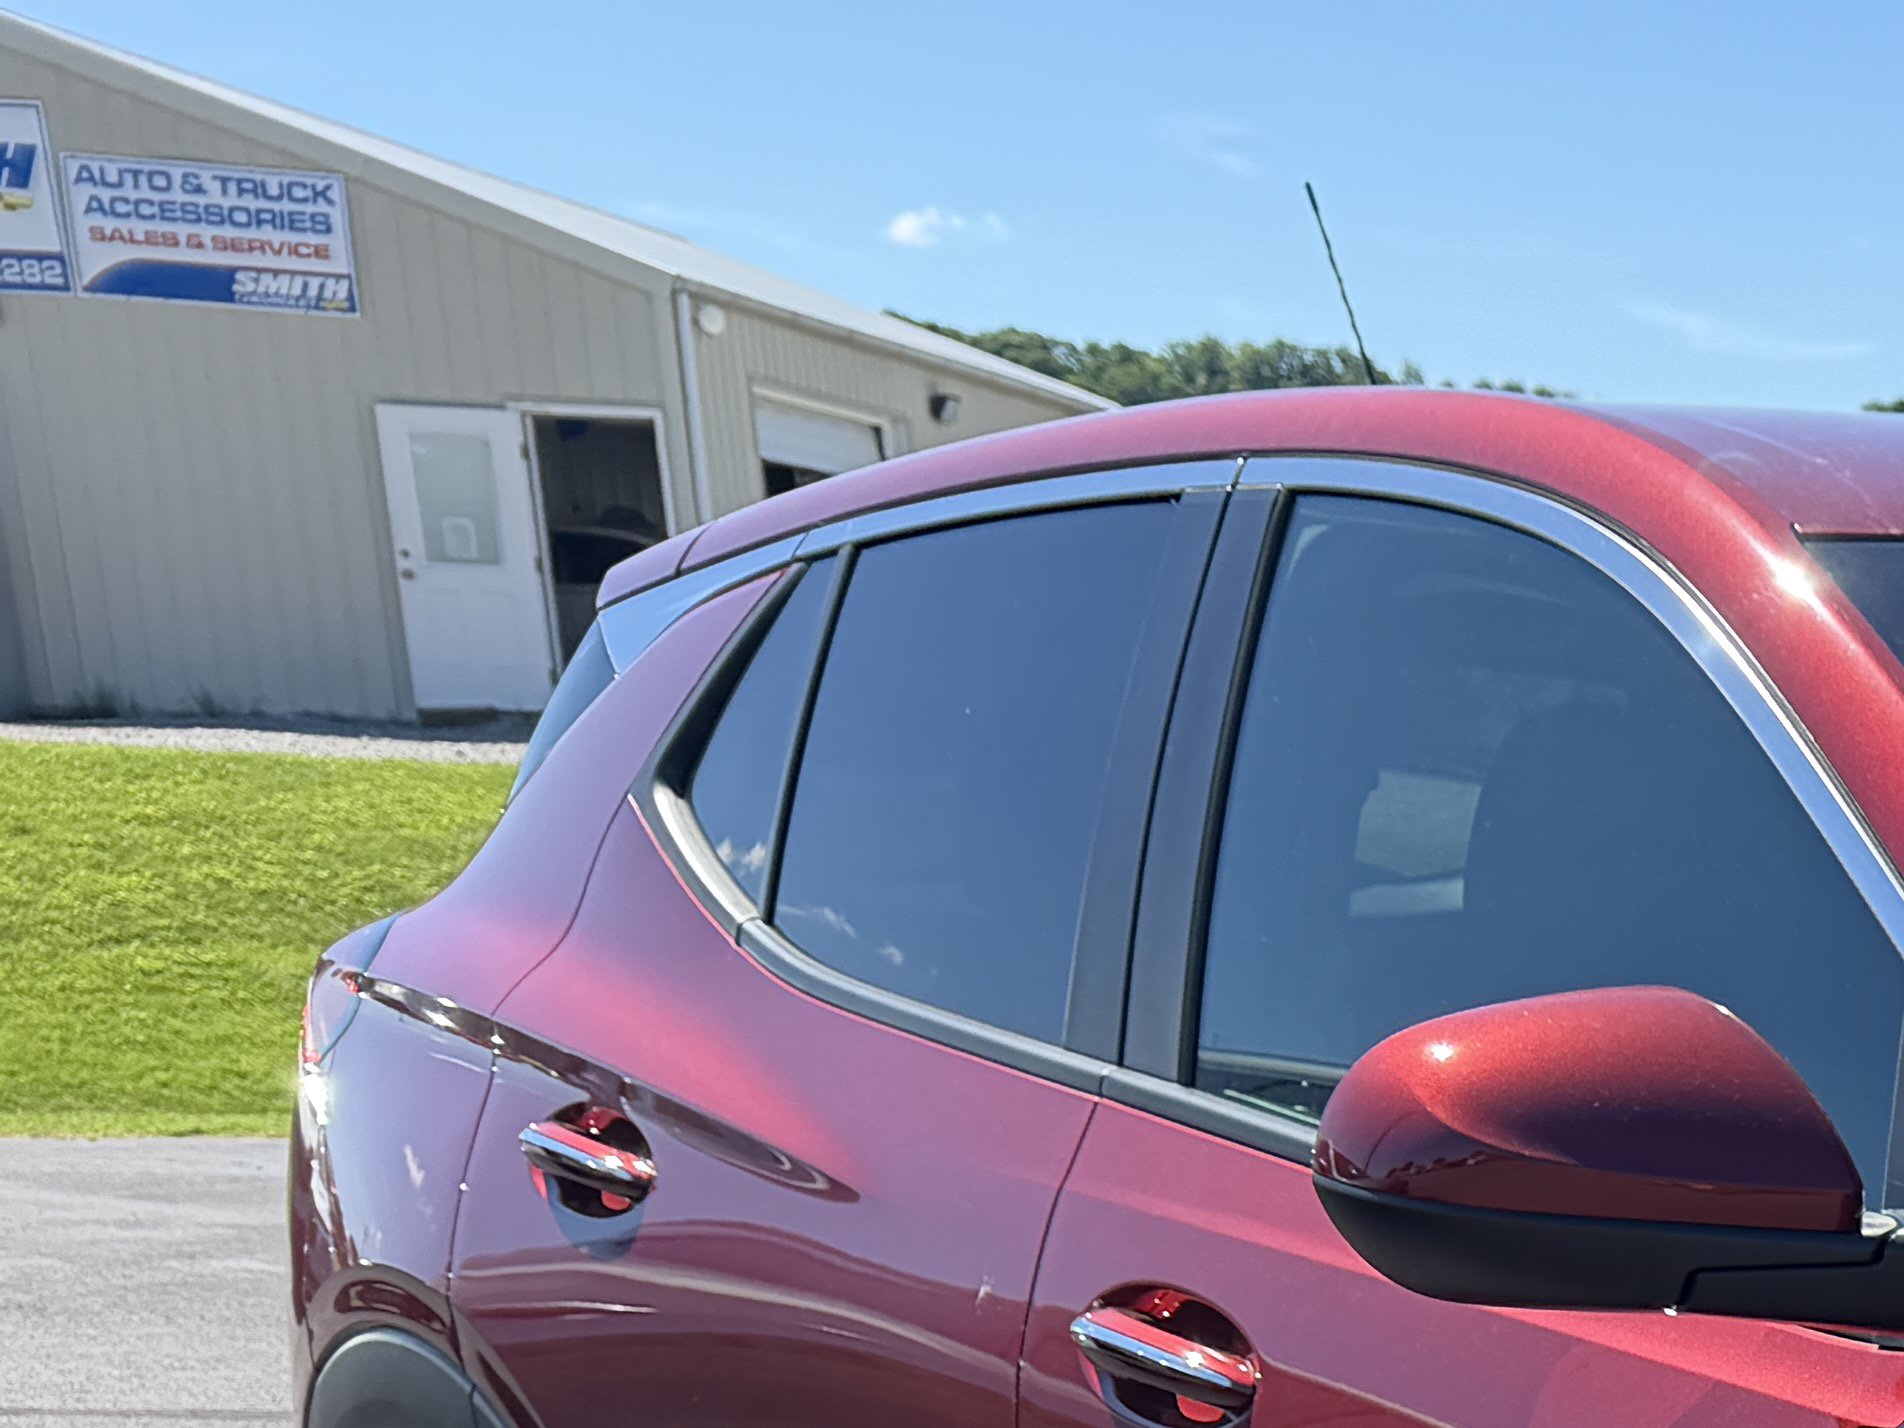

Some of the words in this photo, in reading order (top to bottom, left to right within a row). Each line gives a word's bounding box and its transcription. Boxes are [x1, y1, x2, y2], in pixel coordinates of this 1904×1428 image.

[72, 164, 173, 193] AUTO
[180, 171, 208, 196] &
[211, 174, 337, 208] TRUCK
[83, 193, 333, 235] ACCESSORIES
[88, 225, 181, 249] SALES
[186, 232, 206, 251] &
[210, 234, 332, 261] SERVICE
[232, 270, 350, 300] SMITH
